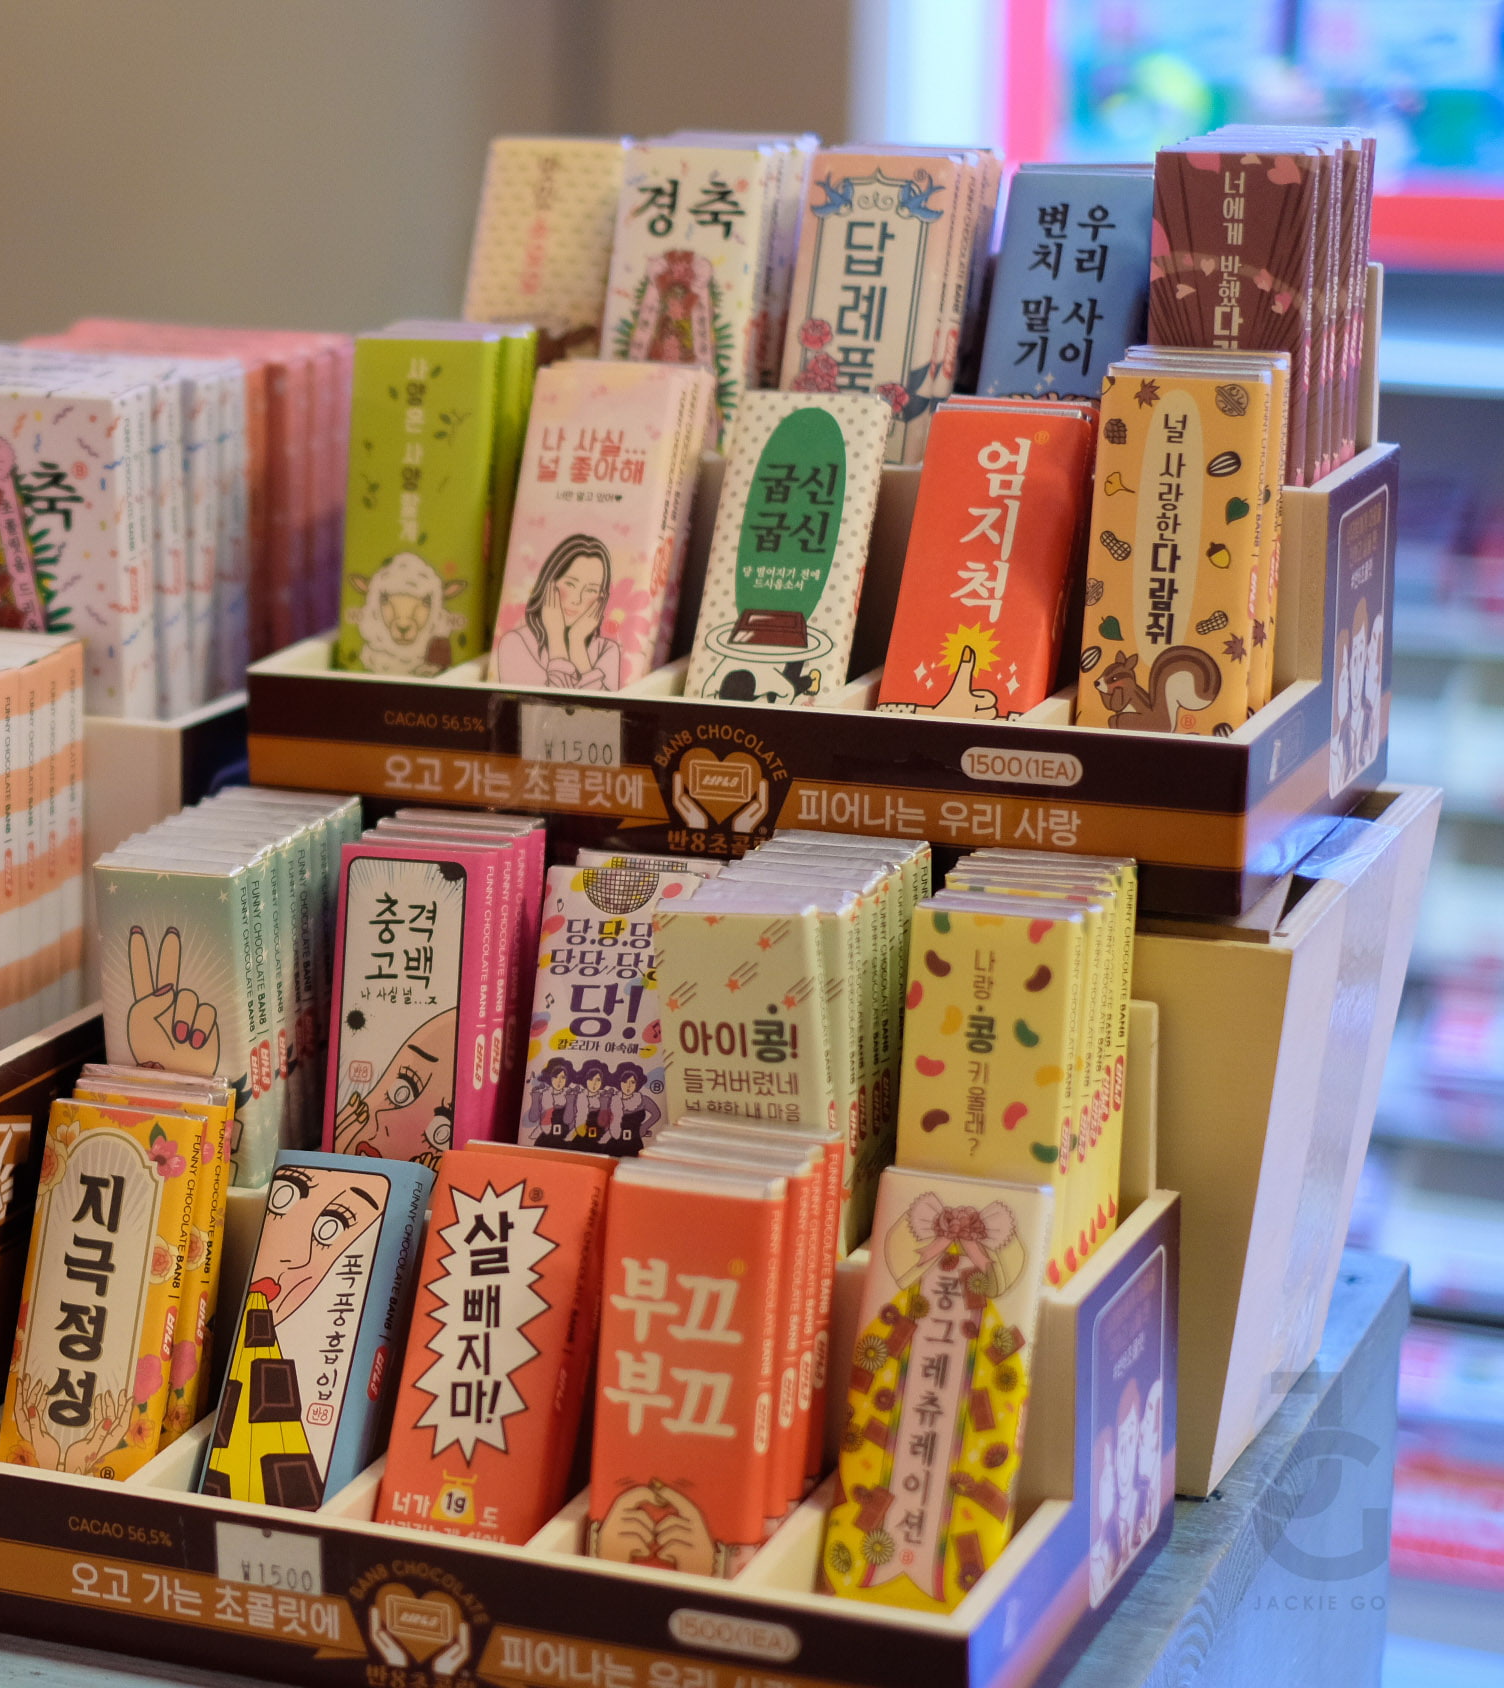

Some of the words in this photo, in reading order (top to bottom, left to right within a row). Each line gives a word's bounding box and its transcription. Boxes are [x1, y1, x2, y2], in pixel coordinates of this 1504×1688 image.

[638, 176, 745, 240] 경축
[1222, 170, 1245, 246] 너에게
[1031, 203, 1070, 284] 변치
[1075, 203, 1116, 284] 우리
[1014, 296, 1061, 377] 말기
[1058, 297, 1105, 378] 사이
[540, 426, 566, 452] 나
[1162, 412, 1188, 445] 널
[536, 456, 559, 484] 널
[569, 456, 646, 486] 좋아해
[758, 462, 841, 507] 굽신
[748, 510, 830, 556] 굽신
[949, 437, 1033, 624] 엄지척
[384, 709, 439, 730] CACAO
[654, 730, 693, 768] BAN8
[696, 724, 788, 782] CHOCOLATE
[966, 752, 1078, 783] 1500(1EA)
[384, 755, 442, 789] 오고
[453, 760, 511, 799] 가는
[522, 765, 645, 811] 초콜릿에
[667, 829, 765, 856] 반8초콜
[797, 788, 927, 836] 피어나는
[938, 800, 1002, 842] 우리
[1013, 807, 1082, 848] 사랑
[368, 891, 437, 945] 충격
[480, 909, 492, 983] CHOCOLATE
[497, 904, 509, 977] CHOCOLATE
[241, 928, 254, 999] CHOCOLATE
[253, 921, 265, 991] CHOCOLATE
[364, 945, 434, 990] 고백
[360, 986, 371, 1000] 나
[376, 986, 399, 1004] 사실
[569, 982, 645, 1040] 당!
[679, 1014, 799, 1064] 아이콩!
[964, 1013, 997, 1055] 콩
[683, 1067, 800, 1098] 들켜버렸네
[186, 1134, 202, 1177] FUNNY
[177, 1178, 196, 1255] CHOCOLATE
[207, 1165, 222, 1238] CHOCOLATE
[409, 1180, 424, 1223] FUNNY
[172, 1255, 185, 1289] BAN8
[392, 1223, 416, 1297] CHOCOLATE
[462, 1211, 515, 1279] 살
[44, 1172, 127, 1430] 지극정성
[316, 1252, 365, 1402] 폭풍흡입
[609, 1256, 743, 1345] 부끄
[603, 1350, 737, 1437] 부끄
[896, 1274, 964, 1546] 콩그레츄레이션
[67, 1514, 124, 1540] CACAO
[391, 1490, 431, 1519] 너가
[444, 1490, 467, 1515] 1g
[478, 1505, 501, 1529] 도
[70, 1561, 133, 1605] 오고
[142, 1571, 203, 1617] 가는
[213, 1584, 342, 1641] 초콜릿에
[391, 1559, 491, 1624] CHOCOLATE
[499, 1634, 636, 1688] 피어나는
